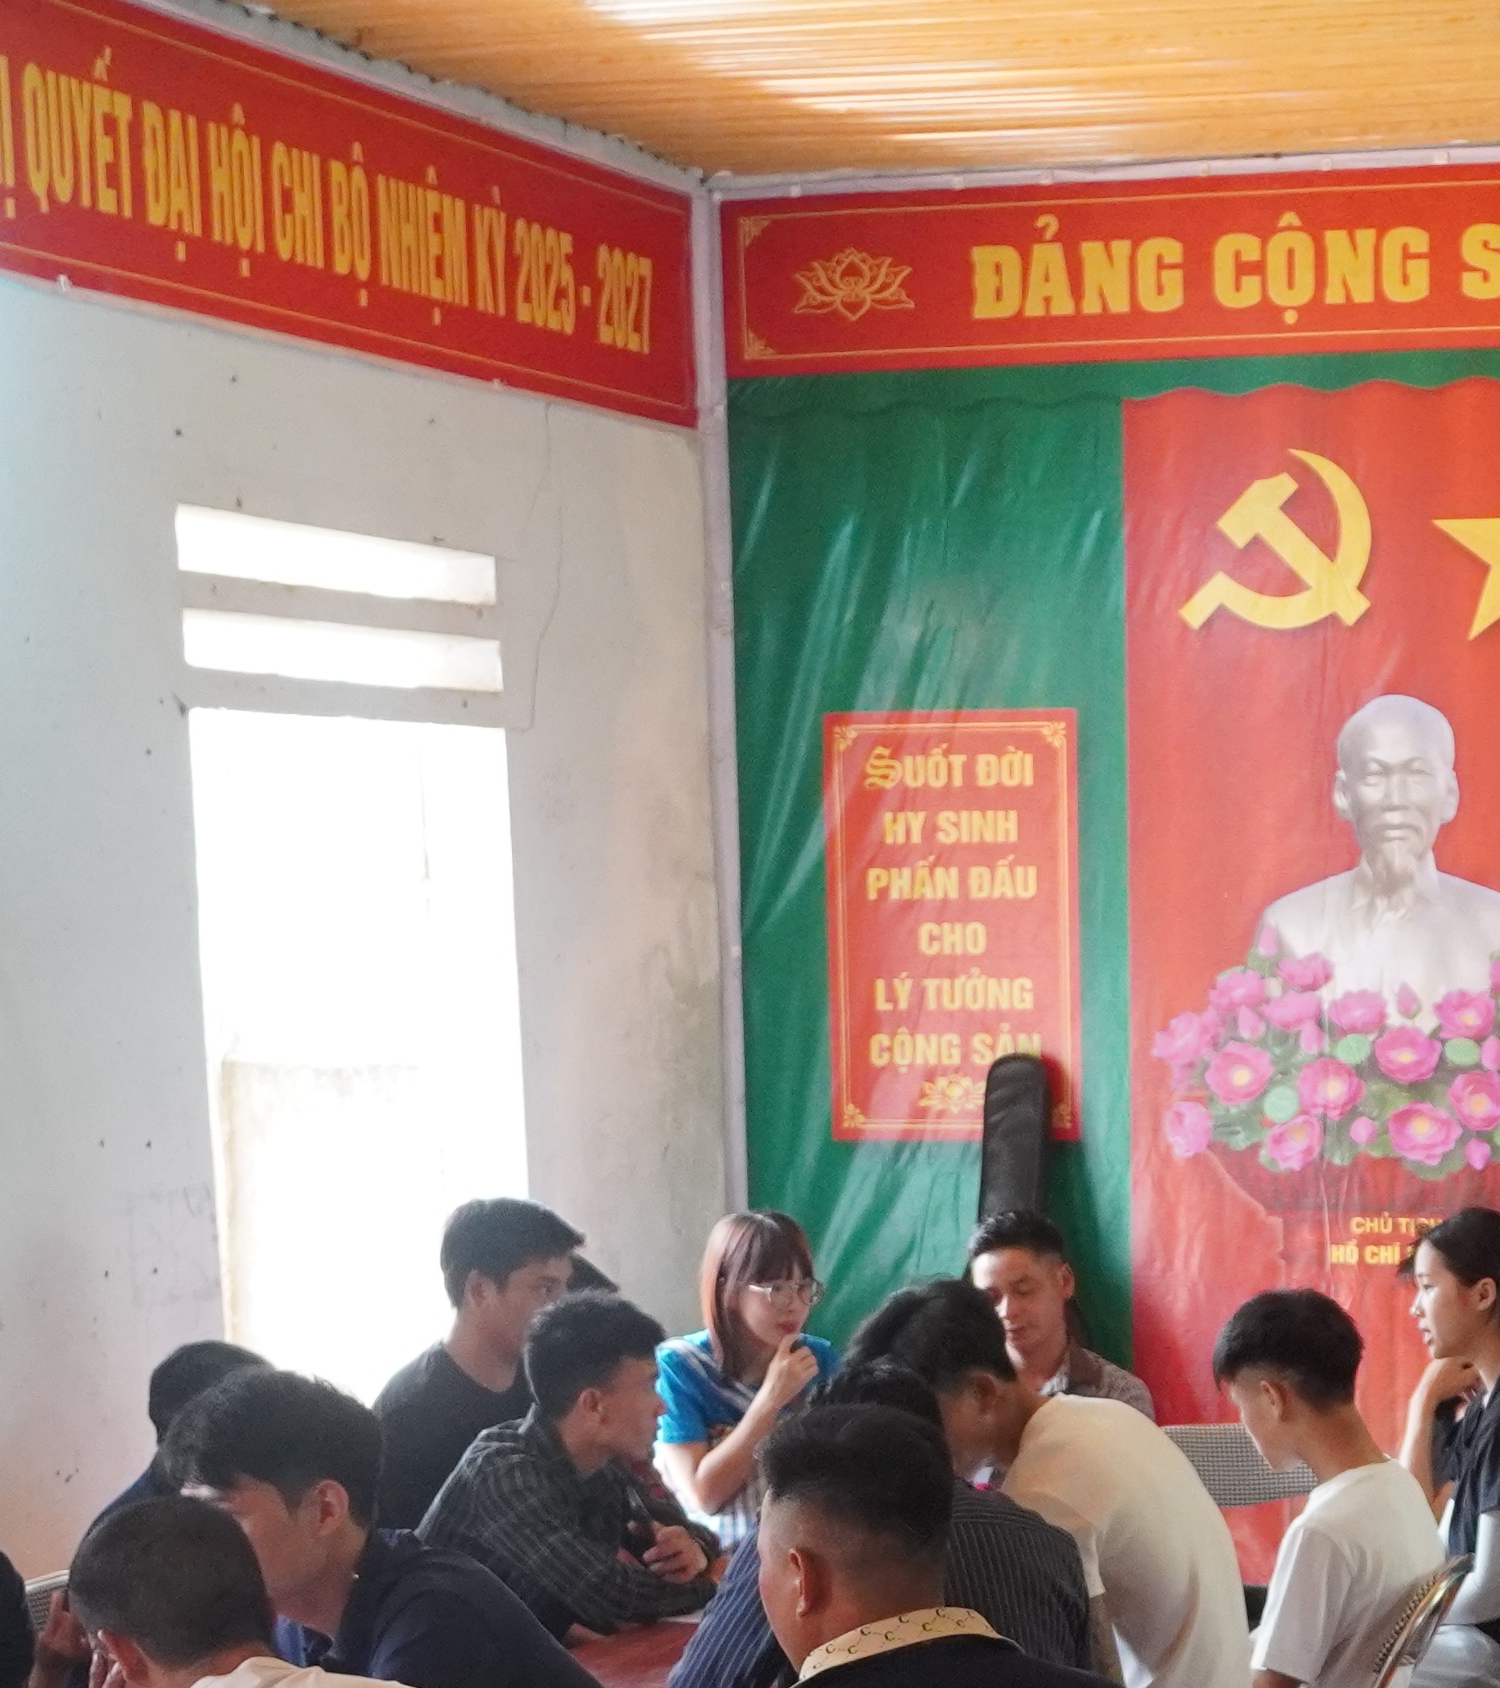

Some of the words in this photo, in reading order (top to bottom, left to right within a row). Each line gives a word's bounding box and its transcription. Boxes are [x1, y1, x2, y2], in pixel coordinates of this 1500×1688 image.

[22, 46, 133, 219] QUYẾT
[142, 100, 201, 262] ĐẠI
[208, 102, 265, 277] HỘI
[271, 141, 324, 270] CHI
[329, 141, 372, 307] BỘ
[377, 165, 469, 325] NHIỆM
[473, 185, 507, 317] KỲ
[514, 218, 576, 336] 2025
[582, 286, 592, 306] -
[598, 244, 653, 354] 2027
[971, 213, 1185, 320] ĐẢNG
[1212, 211, 1431, 325] CỘNG
[863, 743, 967, 791] SUỐT
[976, 746, 1034, 788] ĐỜI
[883, 811, 927, 845] HY
[938, 810, 1019, 845] SINH
[867, 854, 959, 900] PHẤN
[968, 854, 1037, 900] ĐẤU
[918, 922, 988, 957] CHO
[875, 971, 914, 1012] LÝ
[923, 967, 1034, 1011] TƯỞNG
[869, 1027, 961, 1072] CỘNG
[1351, 1211, 1393, 1234] CHỦ
[1364, 1242, 1400, 1265] CHÍ
